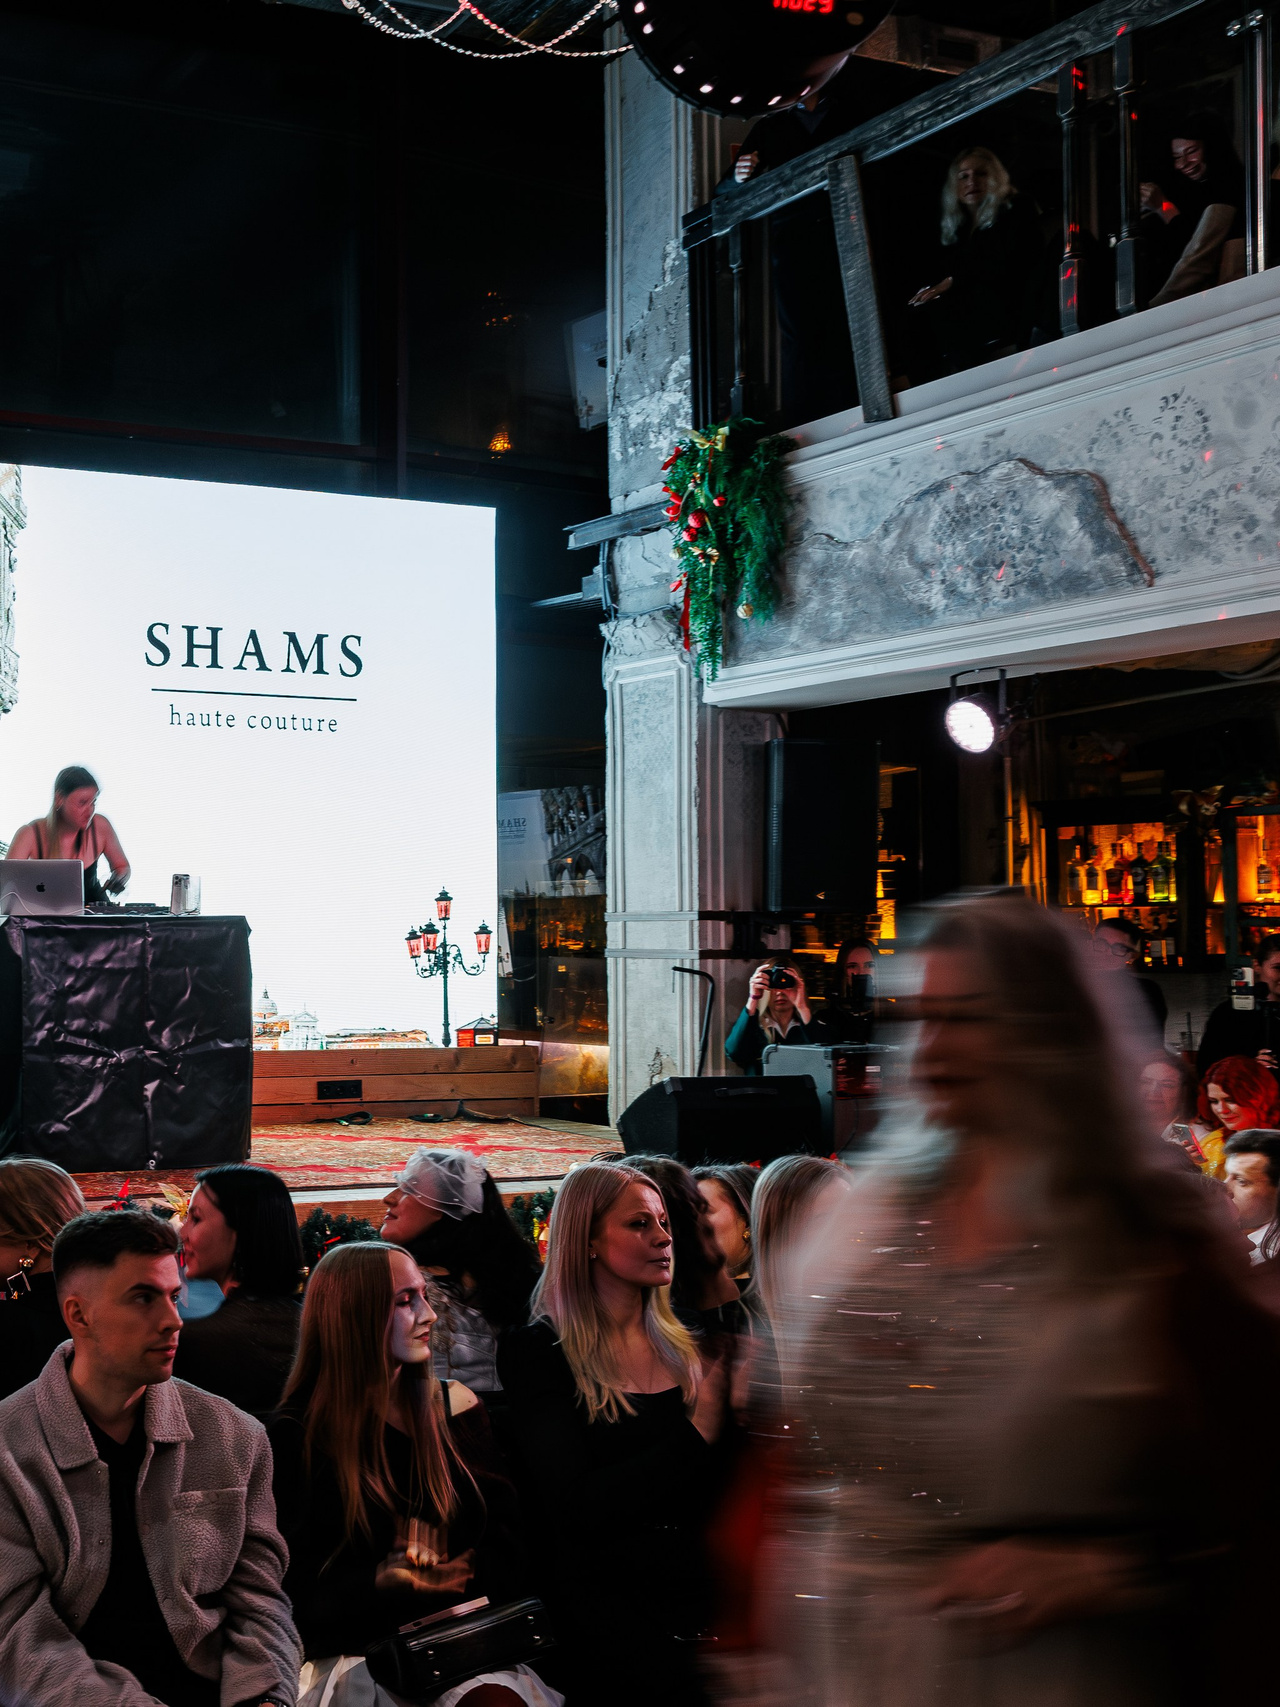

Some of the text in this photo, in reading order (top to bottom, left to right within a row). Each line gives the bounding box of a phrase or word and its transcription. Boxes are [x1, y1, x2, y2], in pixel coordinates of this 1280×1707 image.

[144, 622, 363, 678] SHAMS
[169, 703, 338, 733] haute couture
